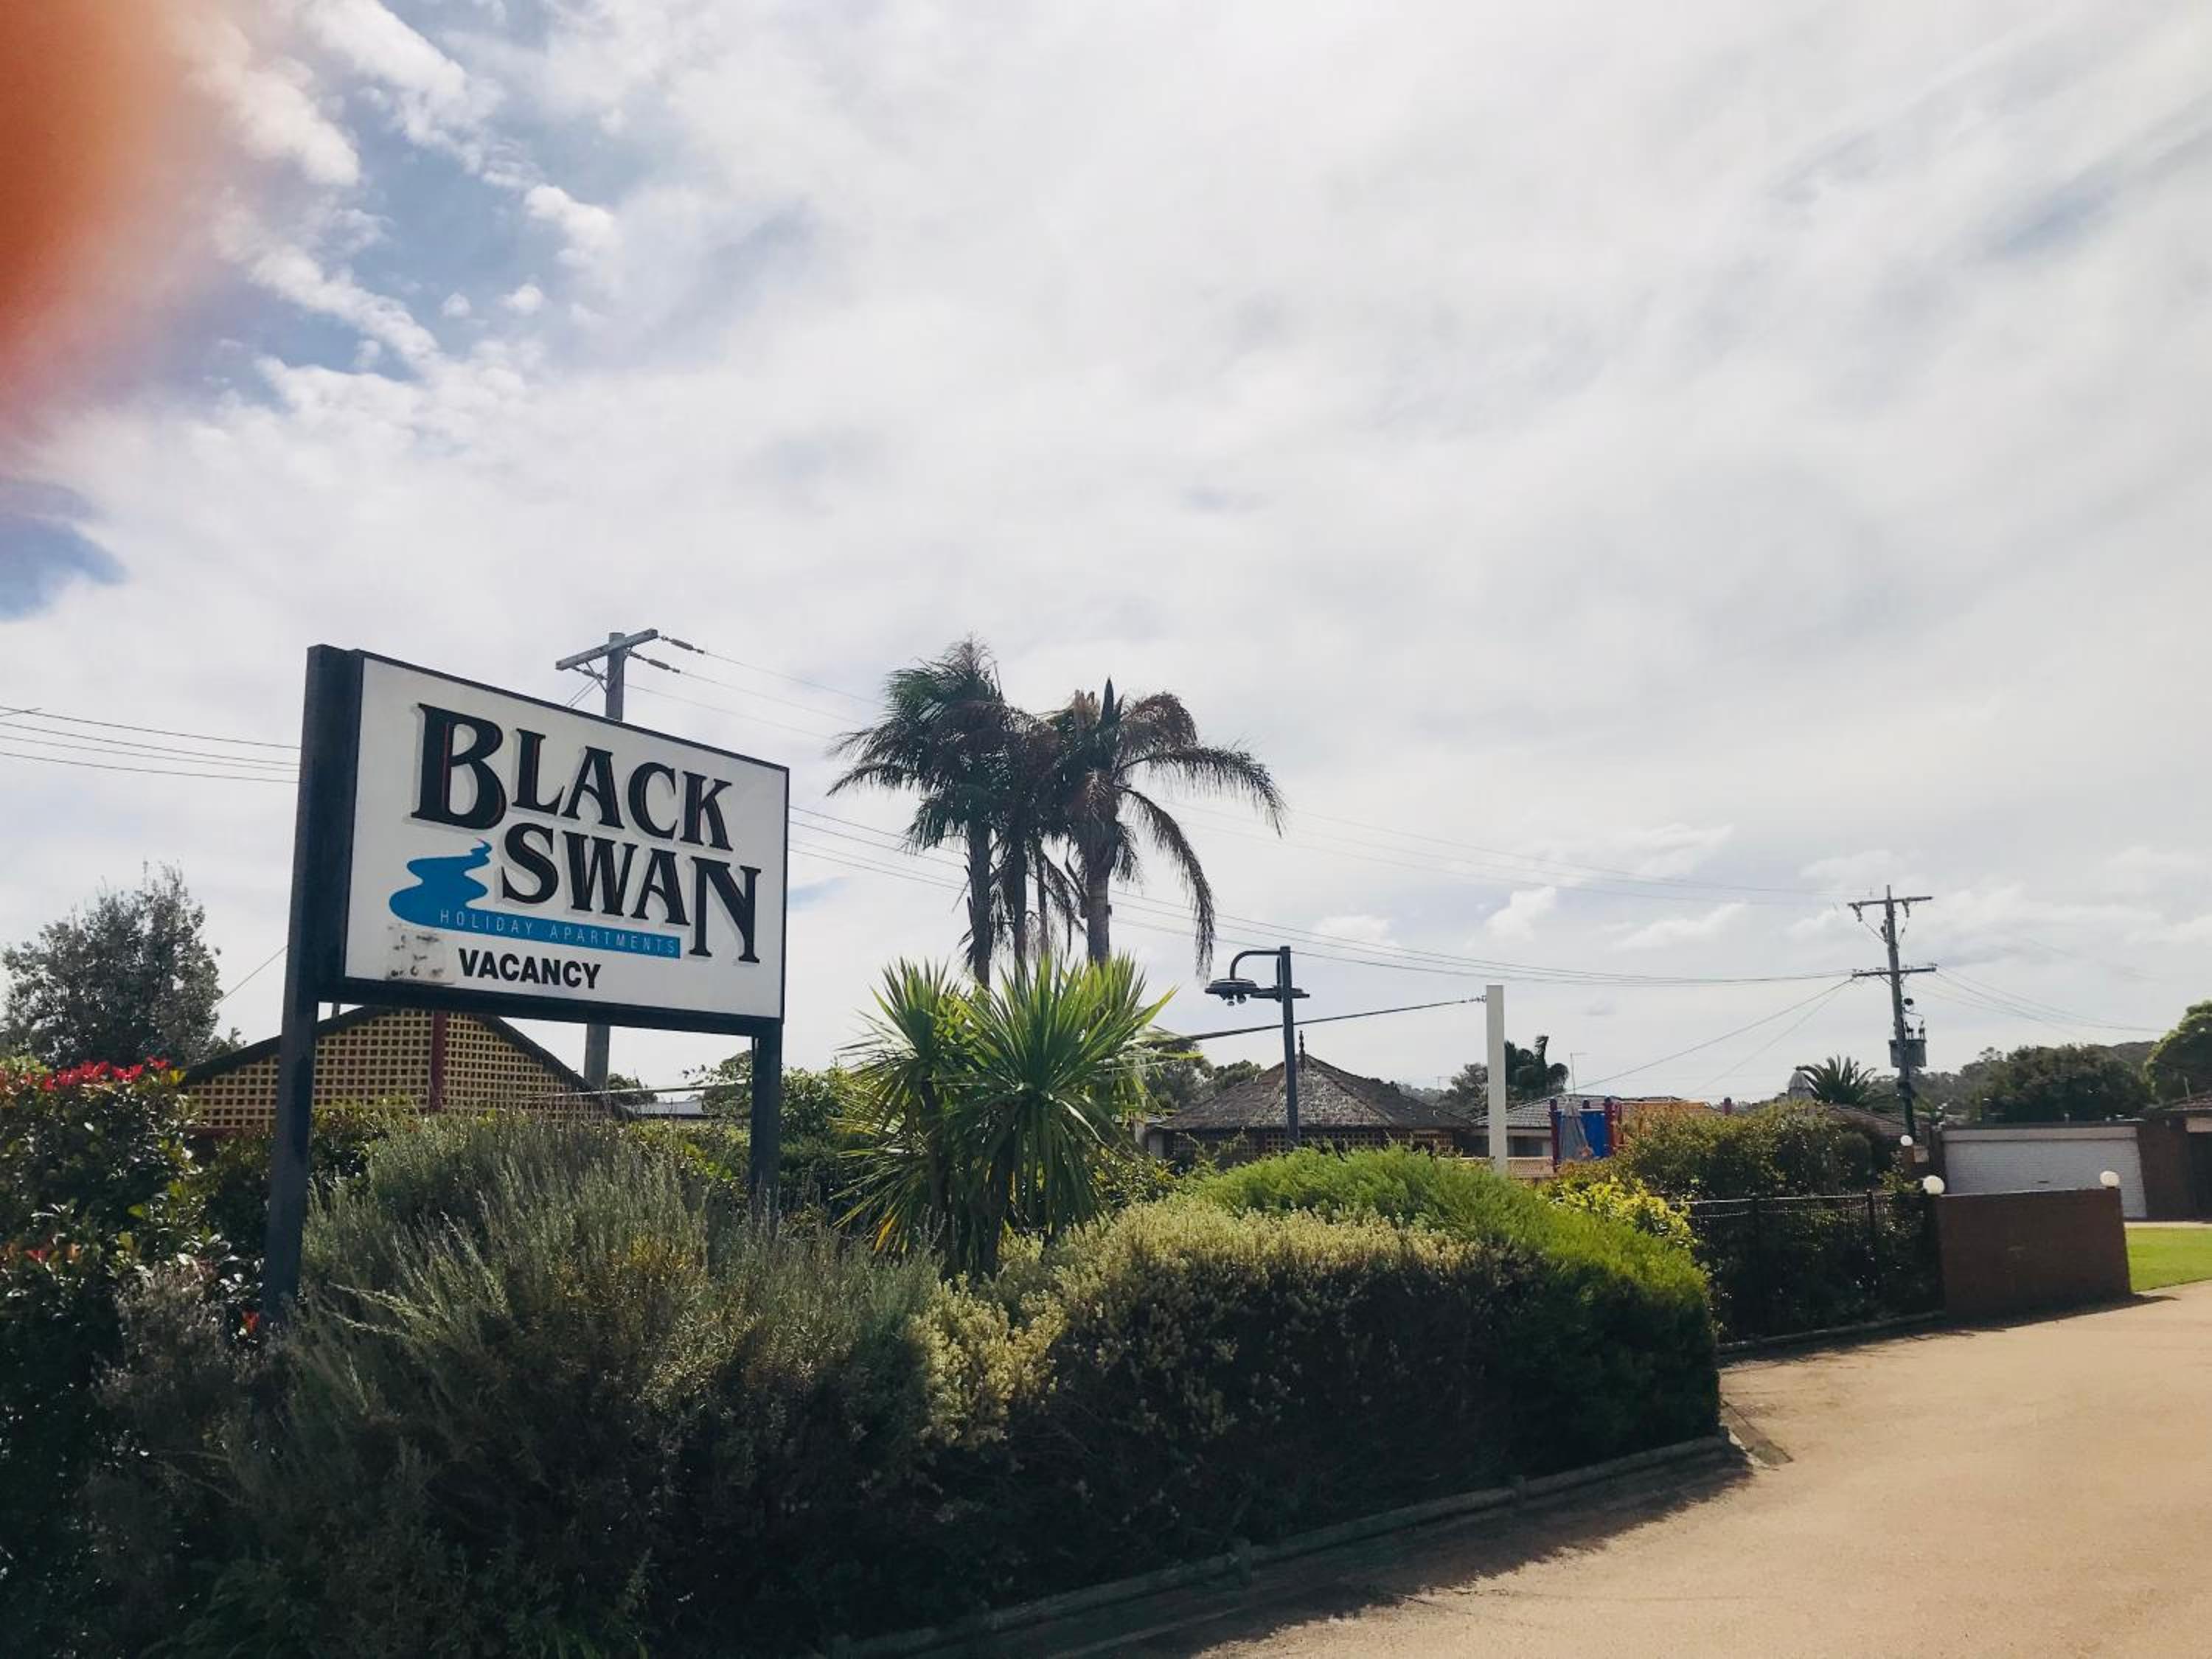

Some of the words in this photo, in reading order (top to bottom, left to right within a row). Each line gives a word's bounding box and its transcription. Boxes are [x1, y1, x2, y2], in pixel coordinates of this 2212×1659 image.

[411, 702, 733, 852] BLACK
[440, 909, 533, 934] HOLIDAY
[550, 926, 675, 953] APARTMENTS
[501, 822, 762, 963] SWAN
[459, 948, 601, 989] VACANCY
